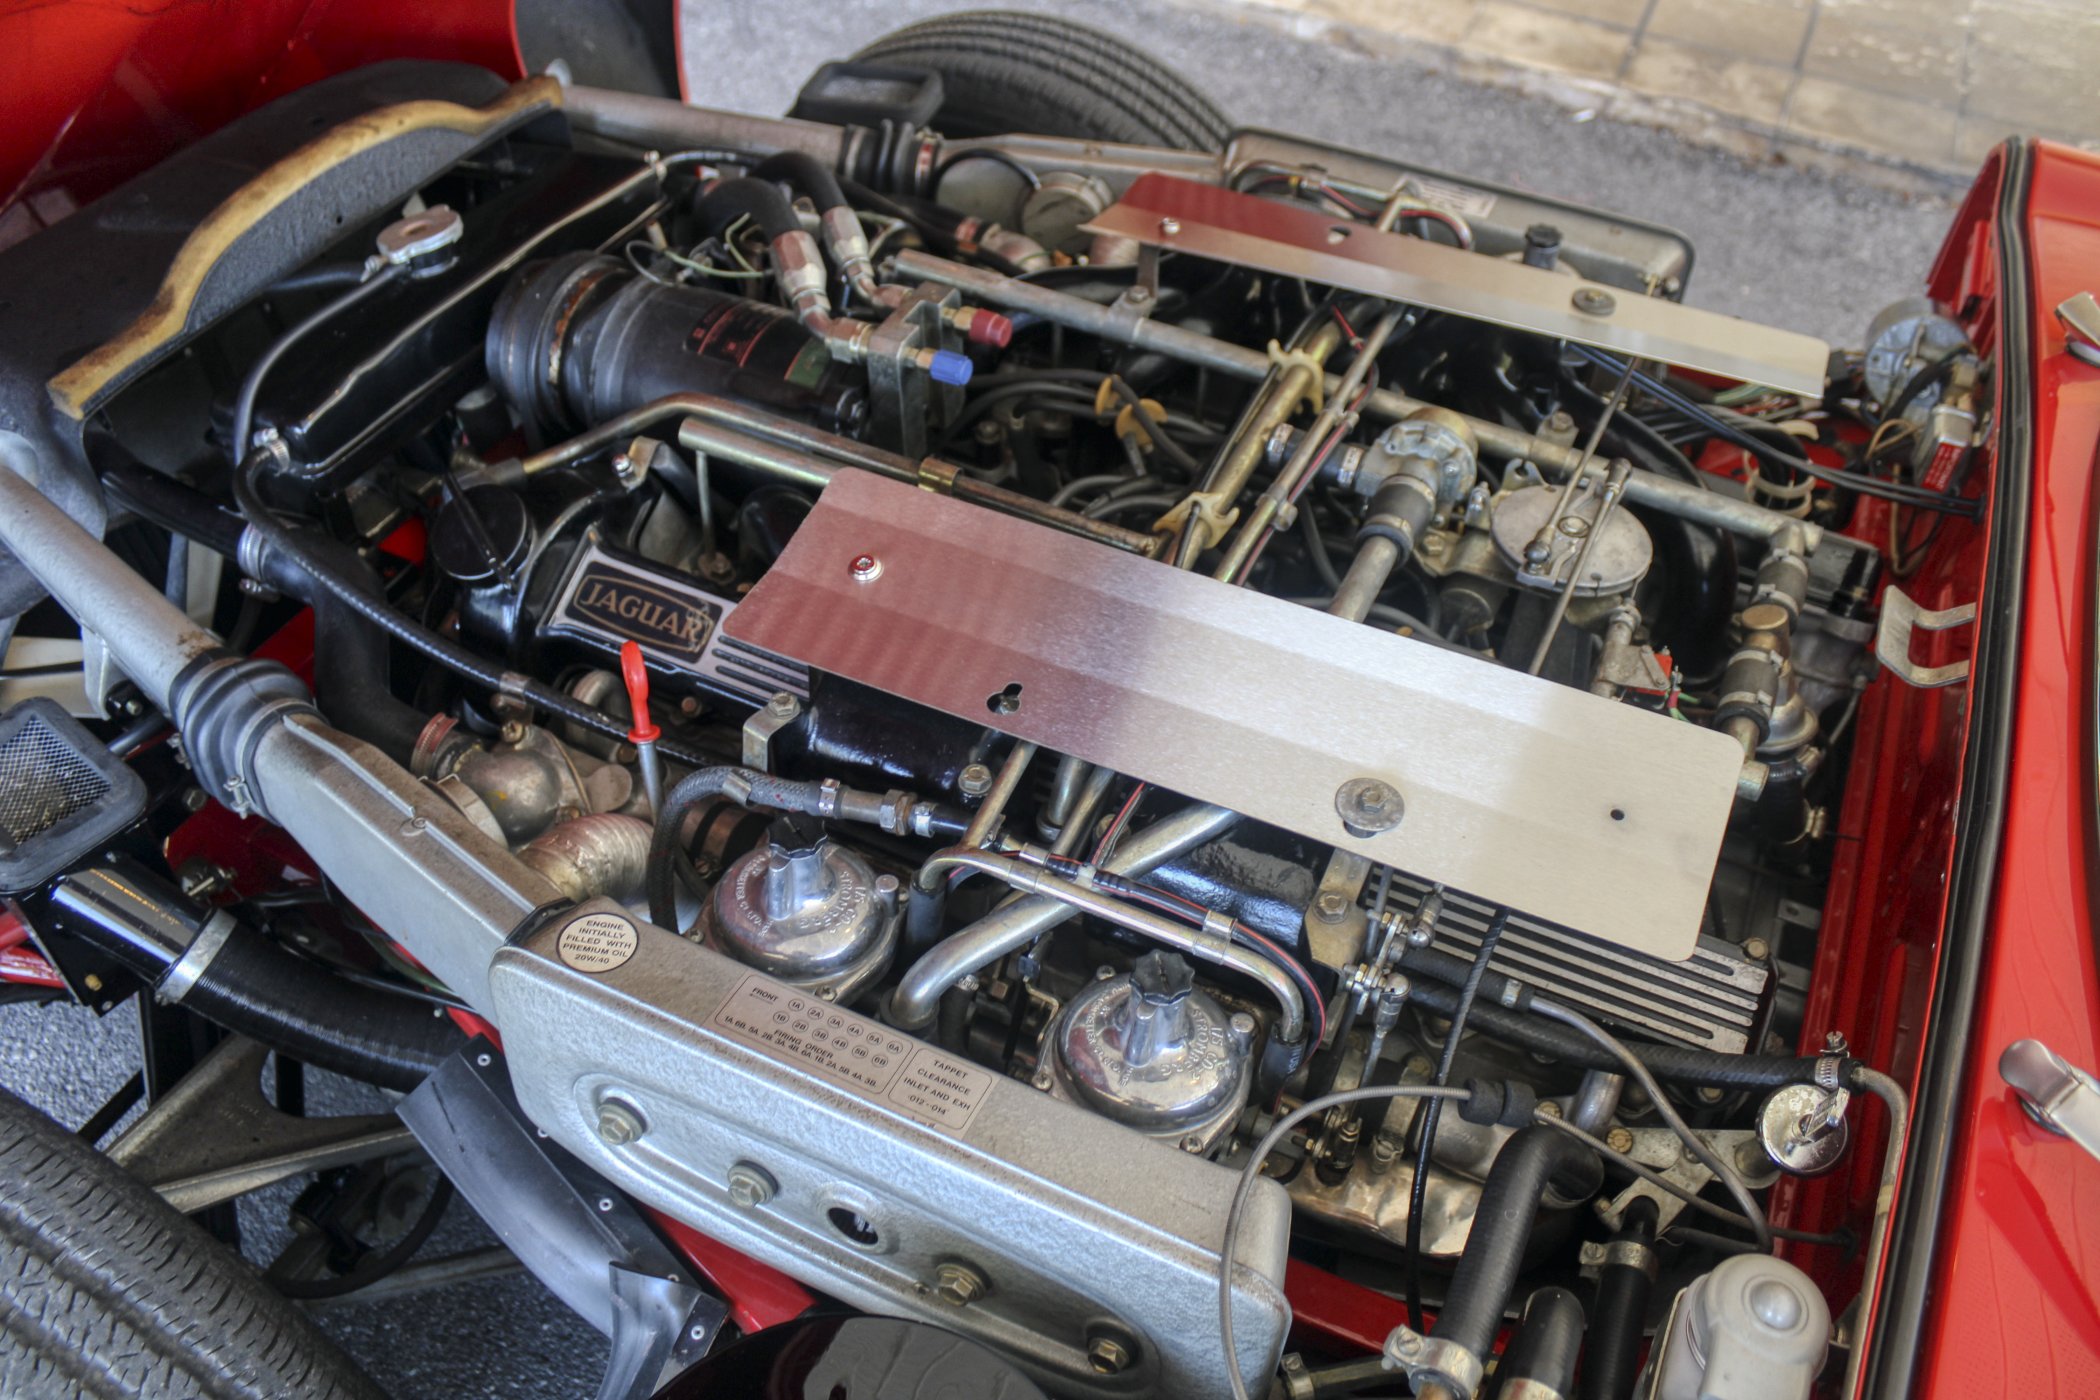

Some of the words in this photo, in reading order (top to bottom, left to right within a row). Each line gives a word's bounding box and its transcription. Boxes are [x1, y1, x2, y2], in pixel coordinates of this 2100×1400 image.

[580, 582, 703, 642] JAGUAR
[579, 927, 626, 939] INITIALLY
[586, 920, 624, 930] ENGINE
[562, 942, 610, 955] PREMIUM
[612, 949, 629, 958] OIL
[566, 934, 601, 945] FILLED
[606, 940, 632, 949] WITH
[574, 953, 610, 964] 20W/40
[752, 987, 778, 1002] FRONT
[792, 1001, 801, 1009] 1A
[810, 1009, 821, 1017] 2A
[830, 1018, 841, 1026] 3A
[848, 1026, 860, 1034] 4A
[868, 1035, 880, 1043] 5A
[888, 1043, 900, 1052] 6A
[1210, 1026, 1224, 1048] 175
[774, 1029, 802, 1045] FIRING
[805, 1043, 834, 1059] ORDER
[794, 1022, 806, 1030] 2B
[814, 1031, 826, 1039] 3B
[834, 1040, 846, 1048] 4B
[854, 1048, 866, 1056] 5B
[874, 1057, 886, 1065] 6B
[1160, 1009, 1209, 1077] STROMBERG
[934, 1059, 969, 1079] TAPPET
[917, 1068, 971, 1096] CLEARANCE
[903, 1077, 930, 1092] INLET
[930, 1089, 950, 1101] AND
[952, 1098, 971, 1111] EXH
